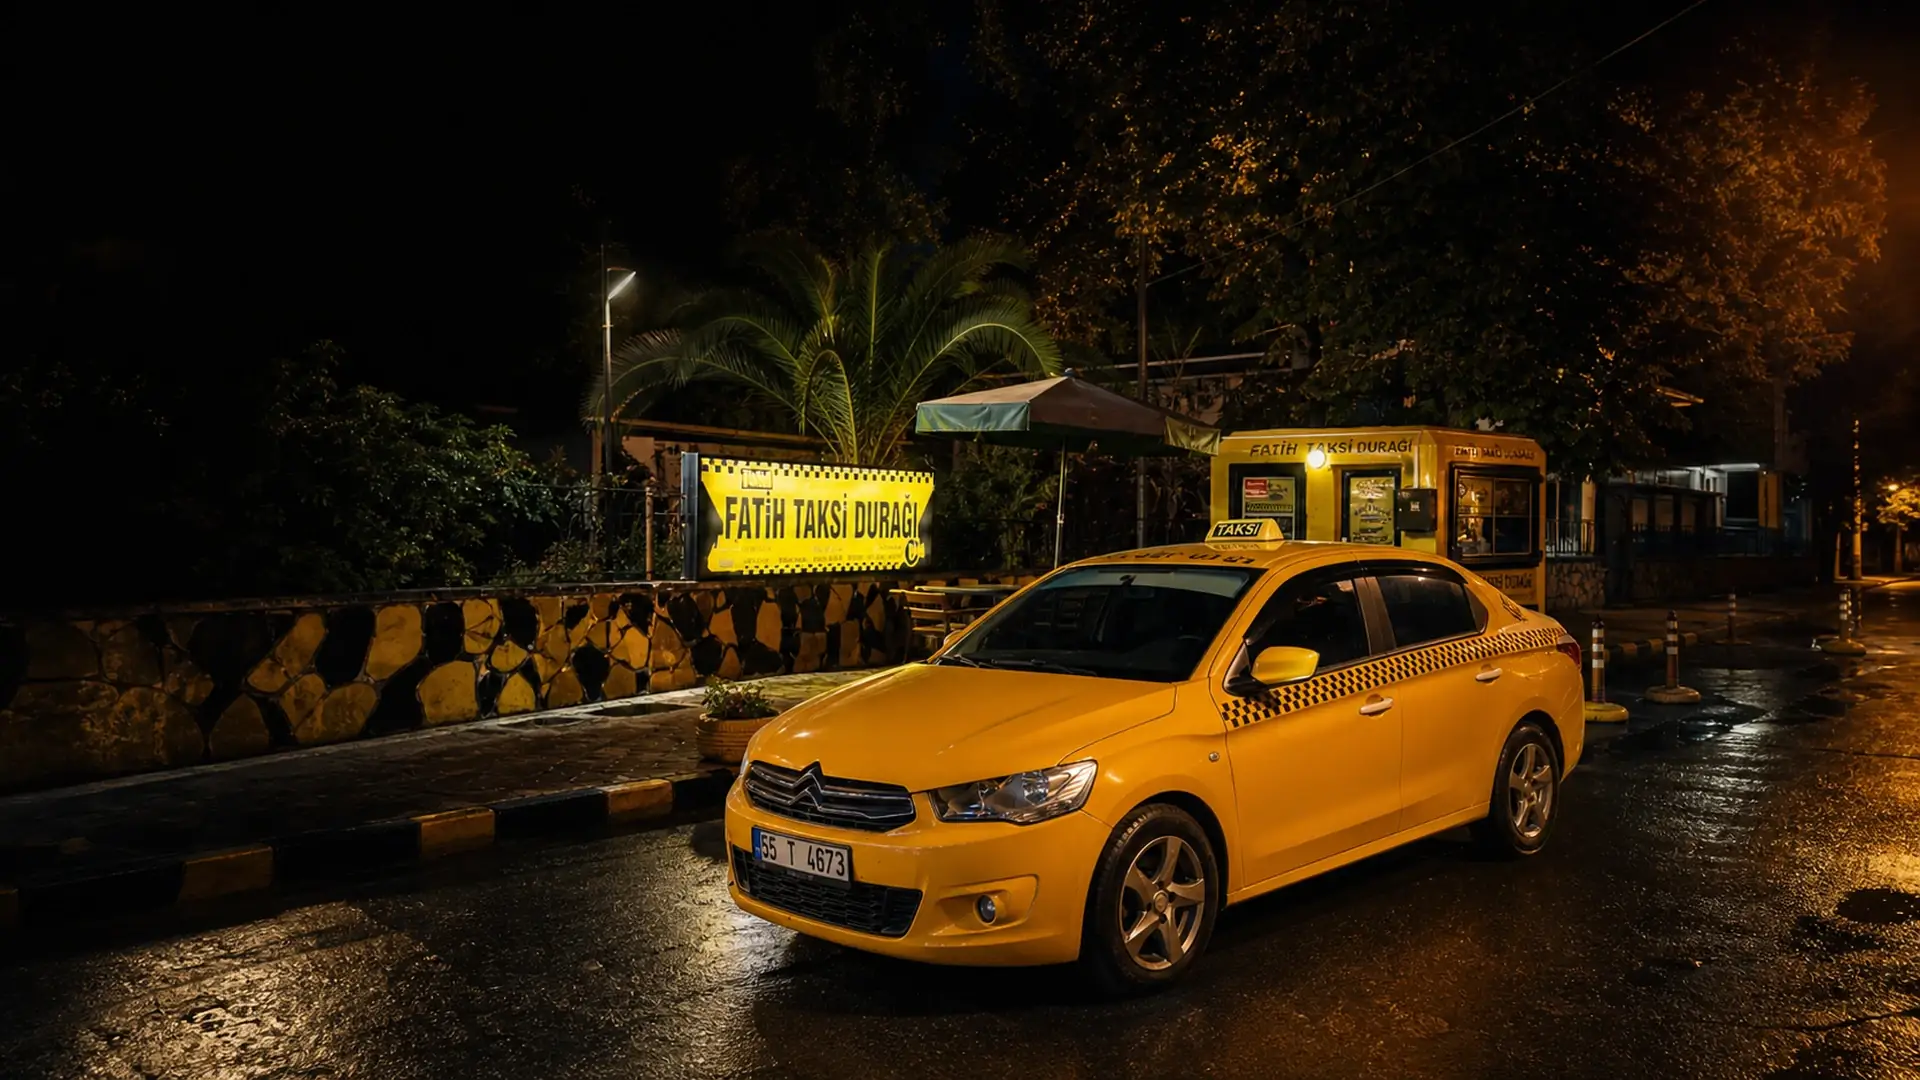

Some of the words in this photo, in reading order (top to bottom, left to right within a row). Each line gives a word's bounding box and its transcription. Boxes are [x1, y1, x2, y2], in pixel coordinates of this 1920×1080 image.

[1250, 440, 1298, 457] FATİH
[1357, 439, 1413, 453] DURAĞI
[725, 490, 785, 540] FATİH
[794, 493, 847, 539] TAKSİ
[855, 494, 918, 539] DURAĞI
[1217, 523, 1260, 536] TAKSI
[761, 834, 777, 861] 55
[787, 840, 796, 866] T
[807, 845, 845, 877] 4673
